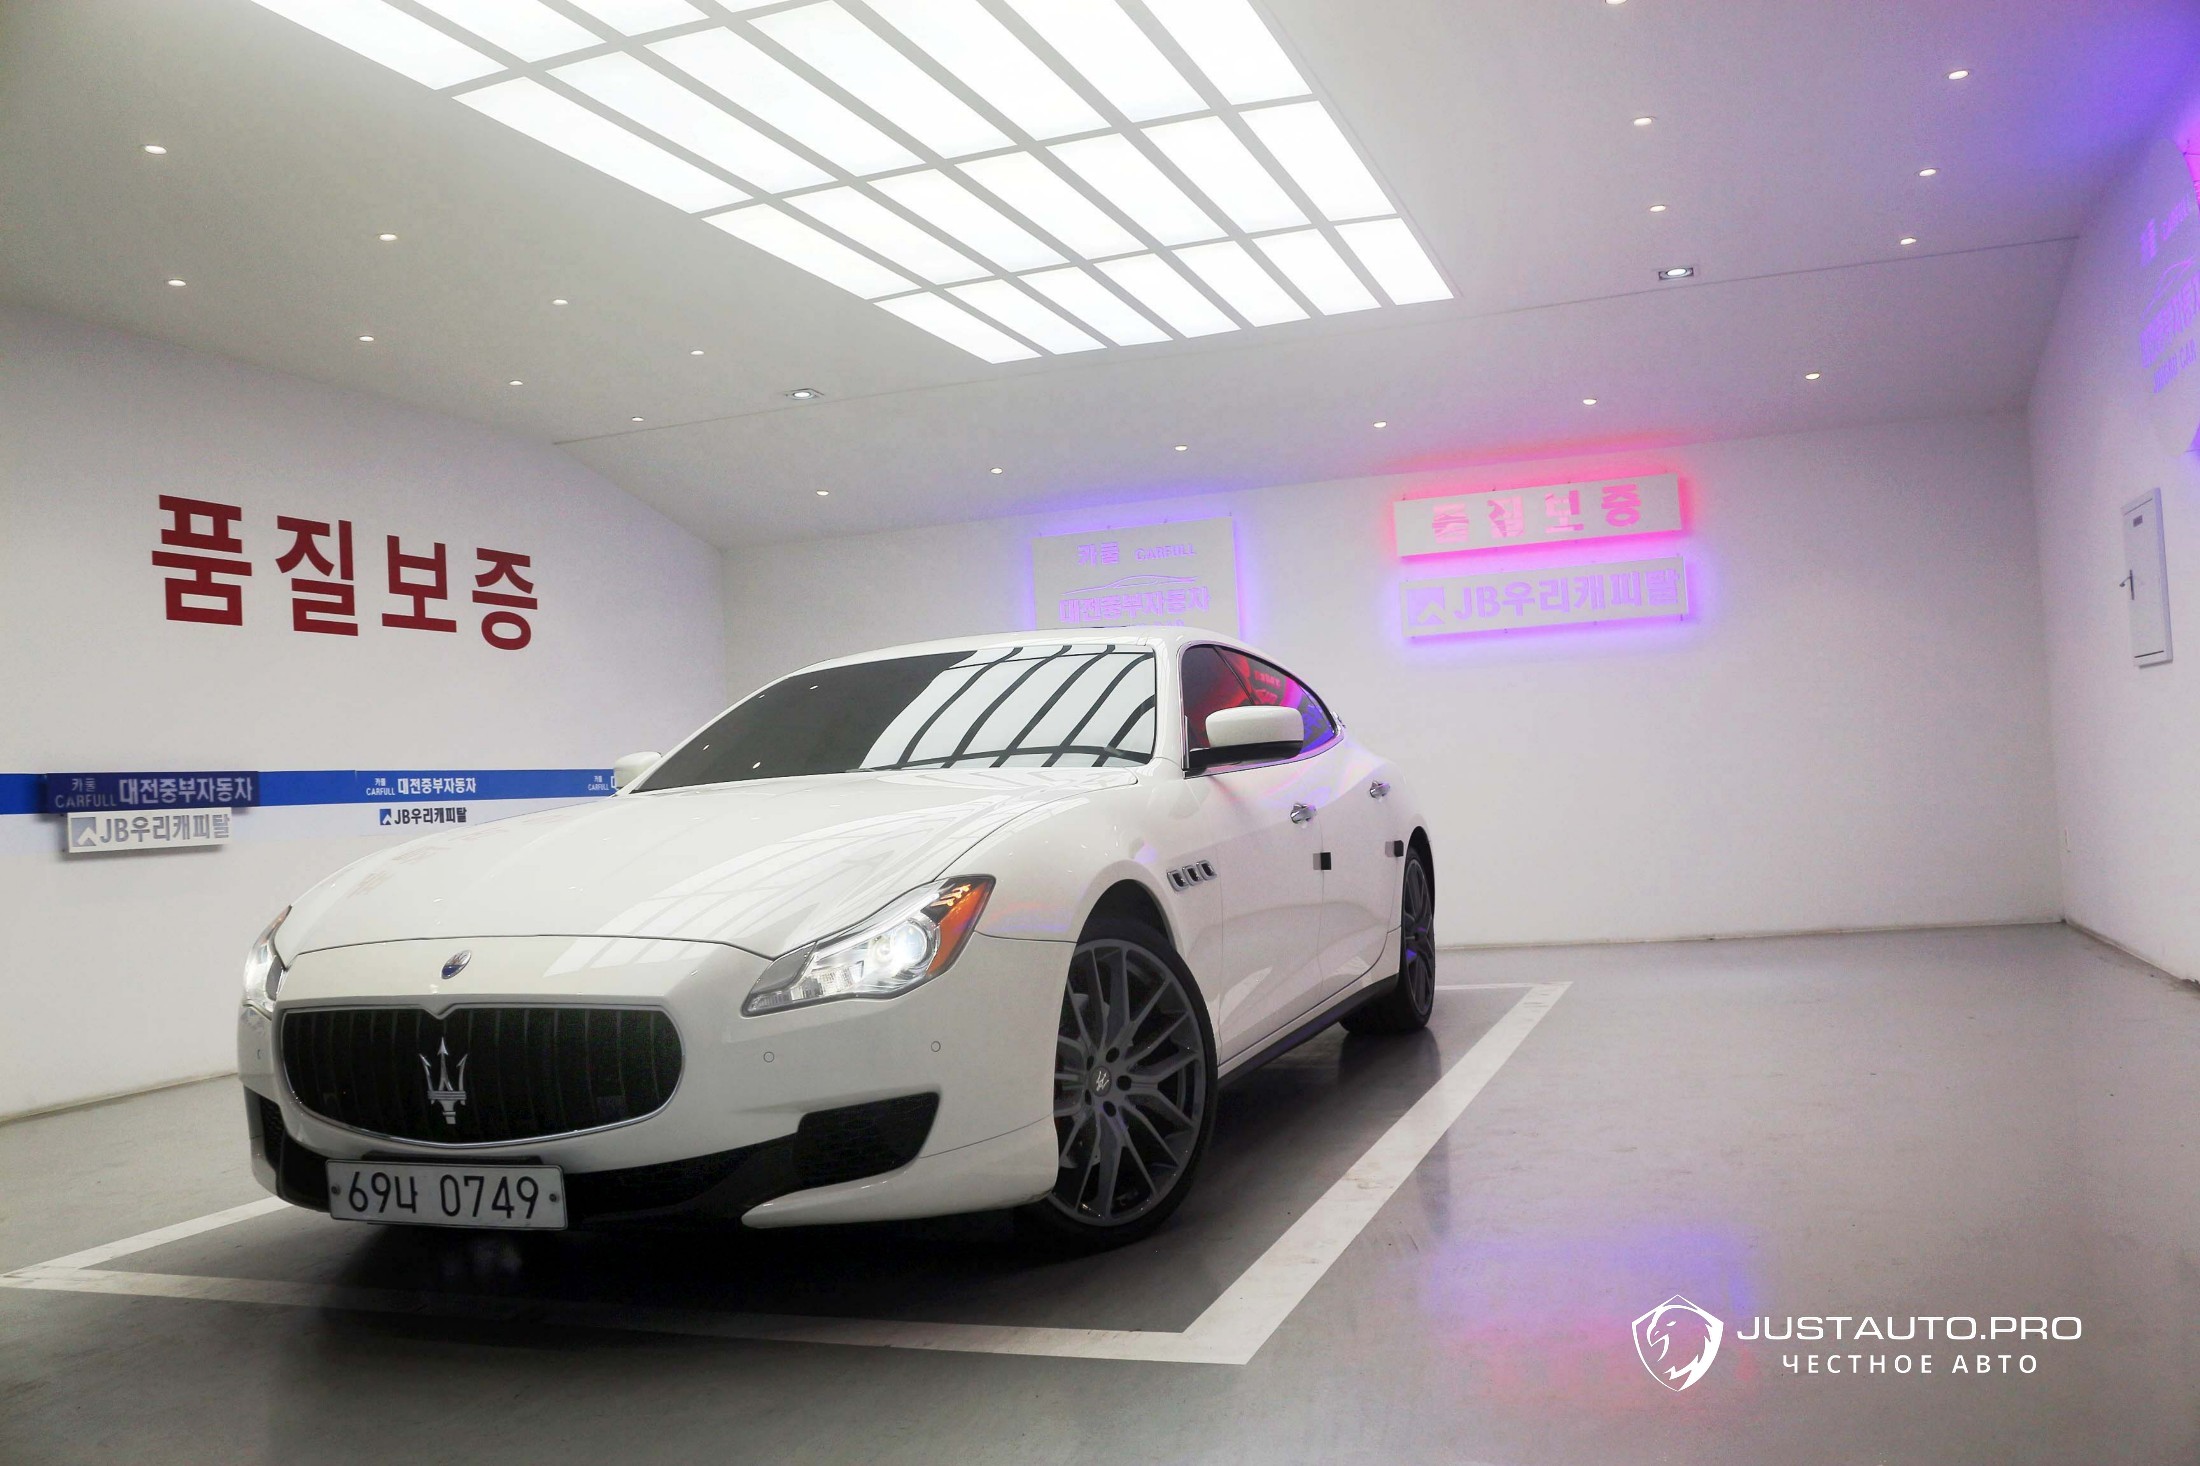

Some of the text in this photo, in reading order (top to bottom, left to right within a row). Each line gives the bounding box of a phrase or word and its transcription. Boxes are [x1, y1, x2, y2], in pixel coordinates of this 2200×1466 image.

[1135, 543, 1196, 561] CARFULL
[152, 494, 538, 650] 품질보증
[119, 776, 253, 805] 대전중부자동차
[366, 787, 396, 796] CARFULL
[397, 777, 477, 795] 대전중부자동차
[55, 793, 117, 809] CARFULL
[394, 807, 468, 825] JB우리캐피탈
[100, 813, 231, 843] JB우리캐피탈
[349, 1171, 540, 1220] 69나 0749
